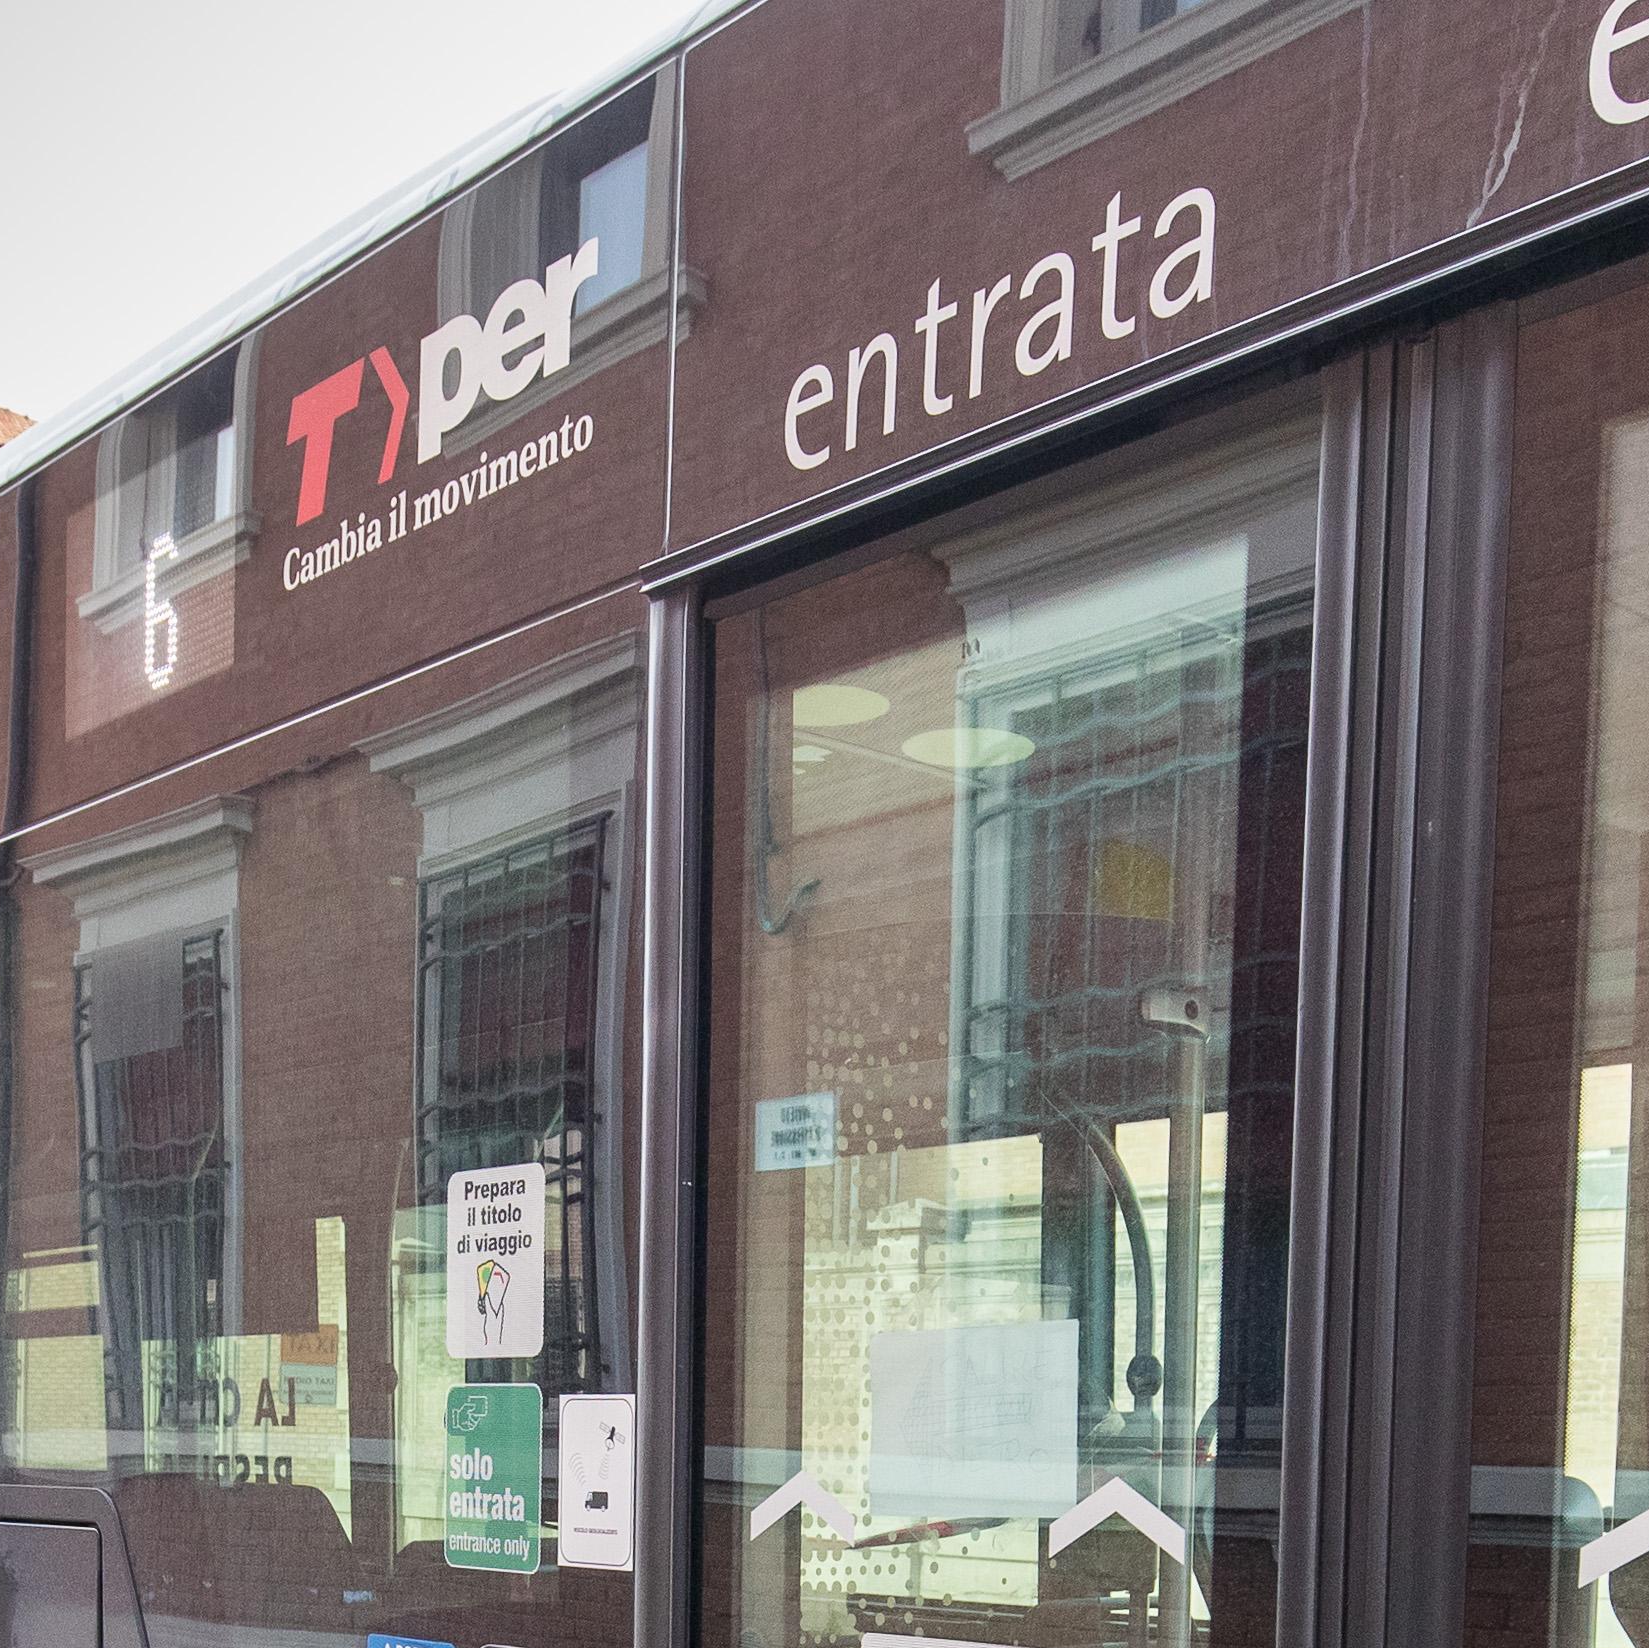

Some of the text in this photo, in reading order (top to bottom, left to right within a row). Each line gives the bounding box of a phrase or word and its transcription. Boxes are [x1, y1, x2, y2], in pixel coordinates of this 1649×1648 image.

[784, 186, 1216, 472] entrata
[282, 411, 594, 592] Cambia il movimento
[465, 1178, 526, 1203] Prepara
[467, 1203, 522, 1226] il titolo
[457, 1230, 532, 1255] di viaggio
[450, 1447, 493, 1481] solo
[449, 1486, 525, 1522] entrata
[449, 1532, 530, 1561] entrance only
